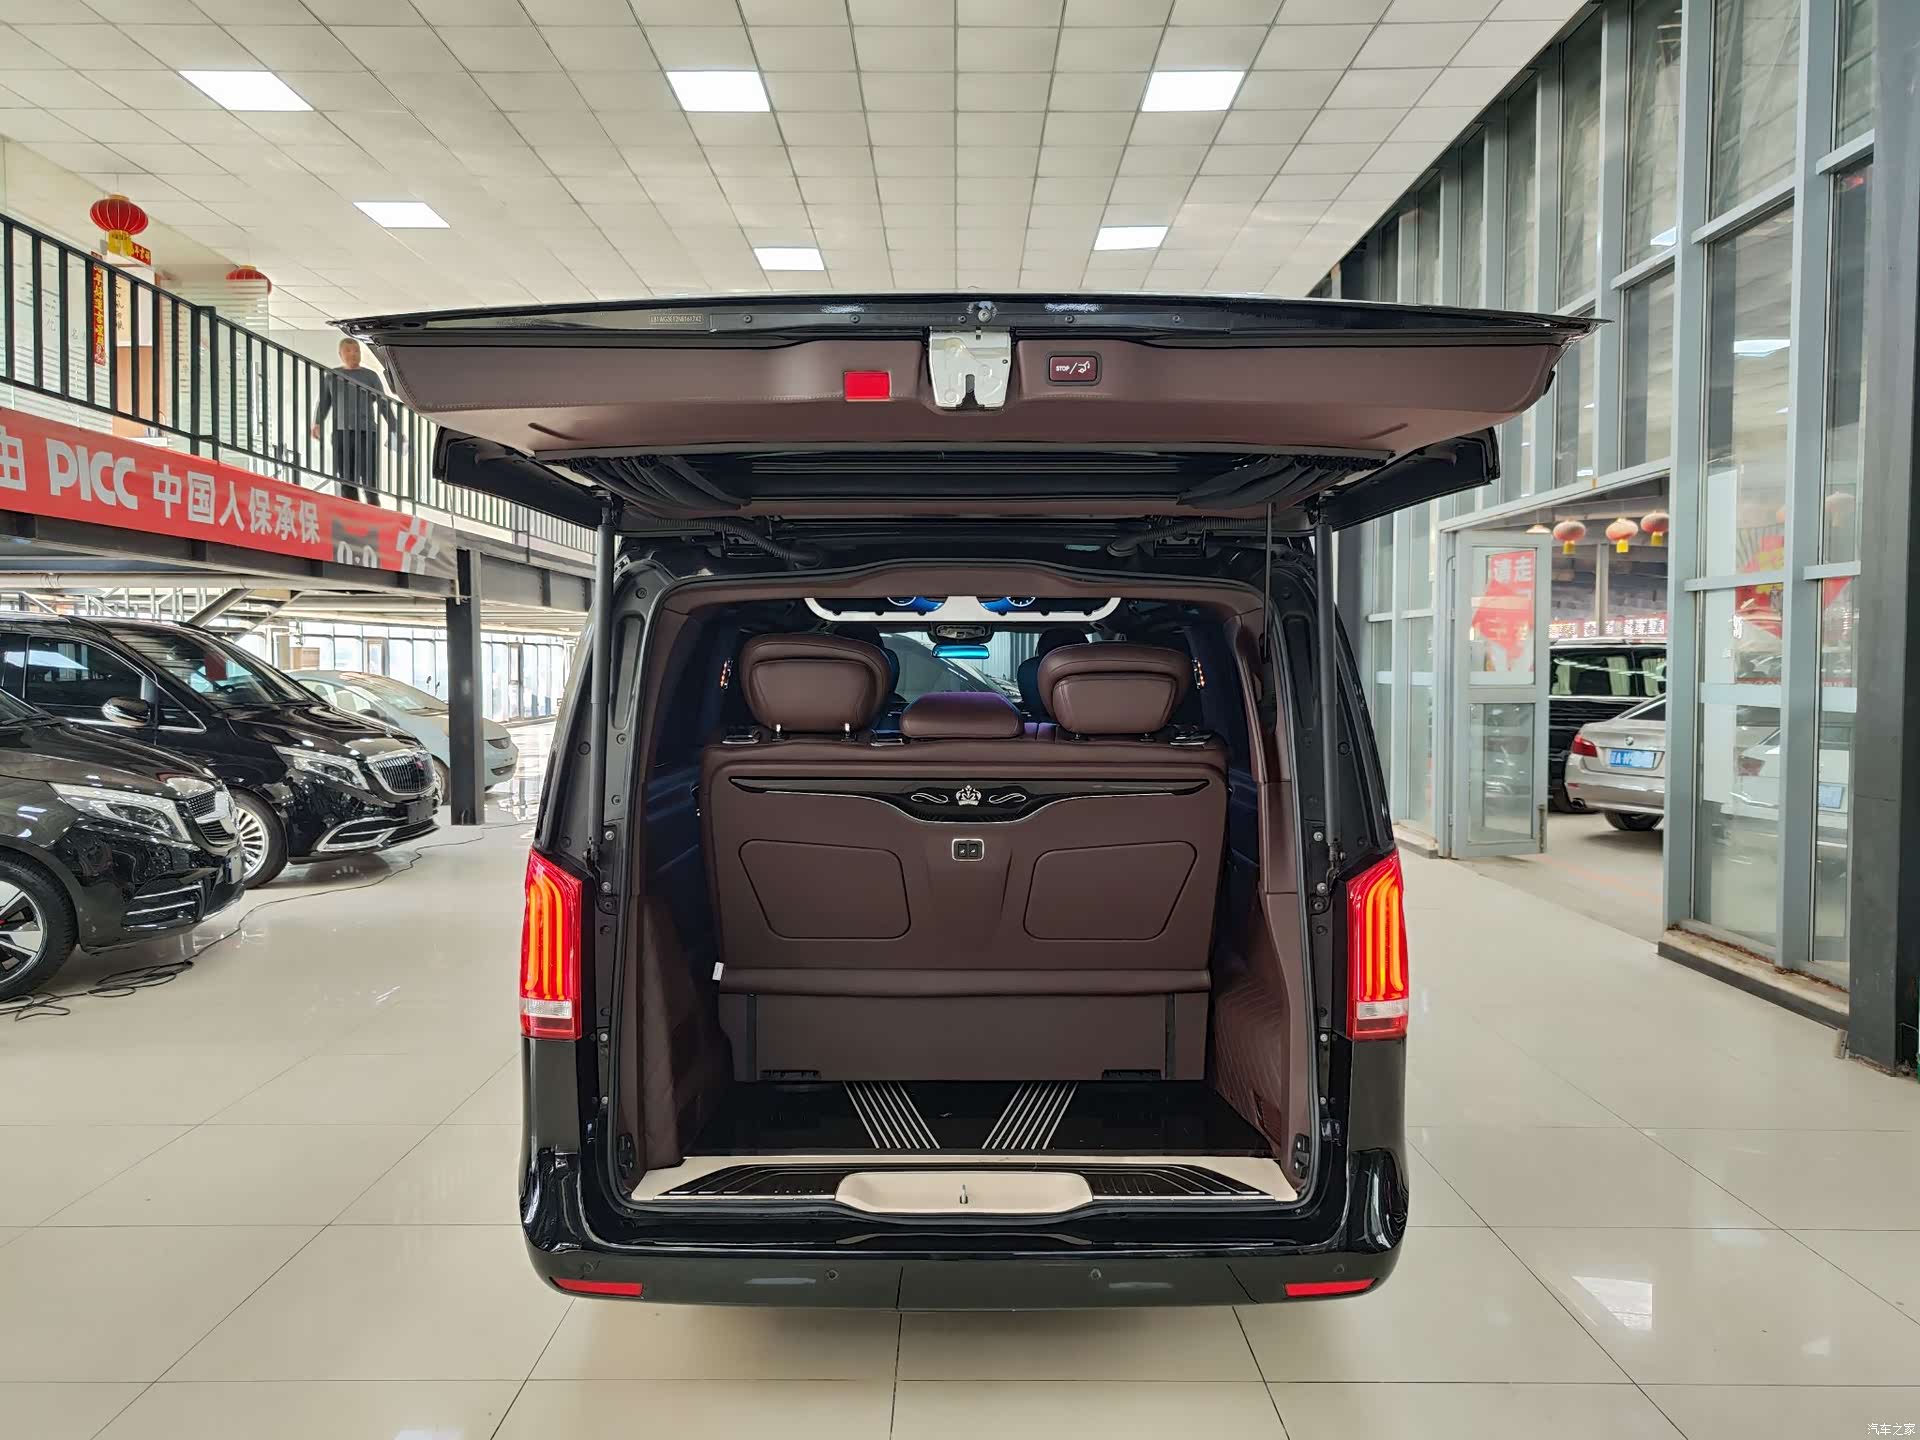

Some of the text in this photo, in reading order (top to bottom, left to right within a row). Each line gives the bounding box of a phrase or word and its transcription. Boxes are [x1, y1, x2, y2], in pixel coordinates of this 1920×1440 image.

[46, 438, 138, 510] PICC
[152, 464, 320, 544] 中国人保承保
